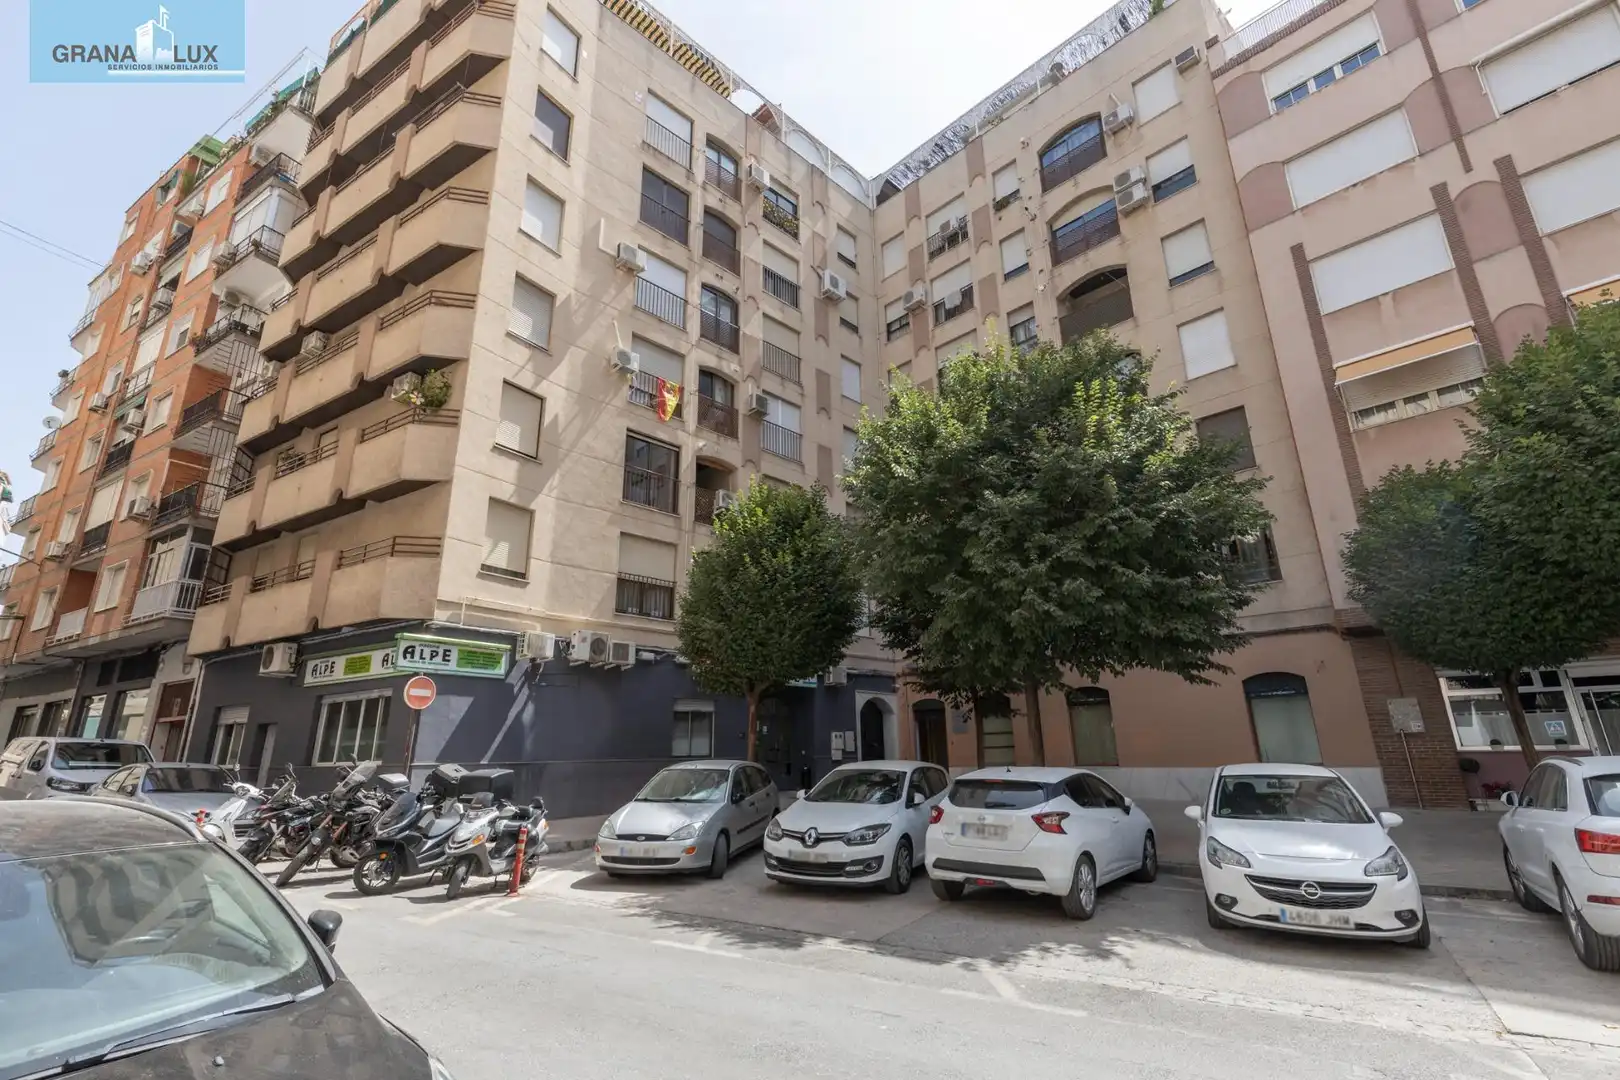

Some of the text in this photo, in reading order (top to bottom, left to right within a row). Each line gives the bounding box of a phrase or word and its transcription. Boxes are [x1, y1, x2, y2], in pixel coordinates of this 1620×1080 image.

[381, 653, 395, 669] AL
[402, 645, 452, 662] ALPE
[311, 661, 336, 677] ALPE
